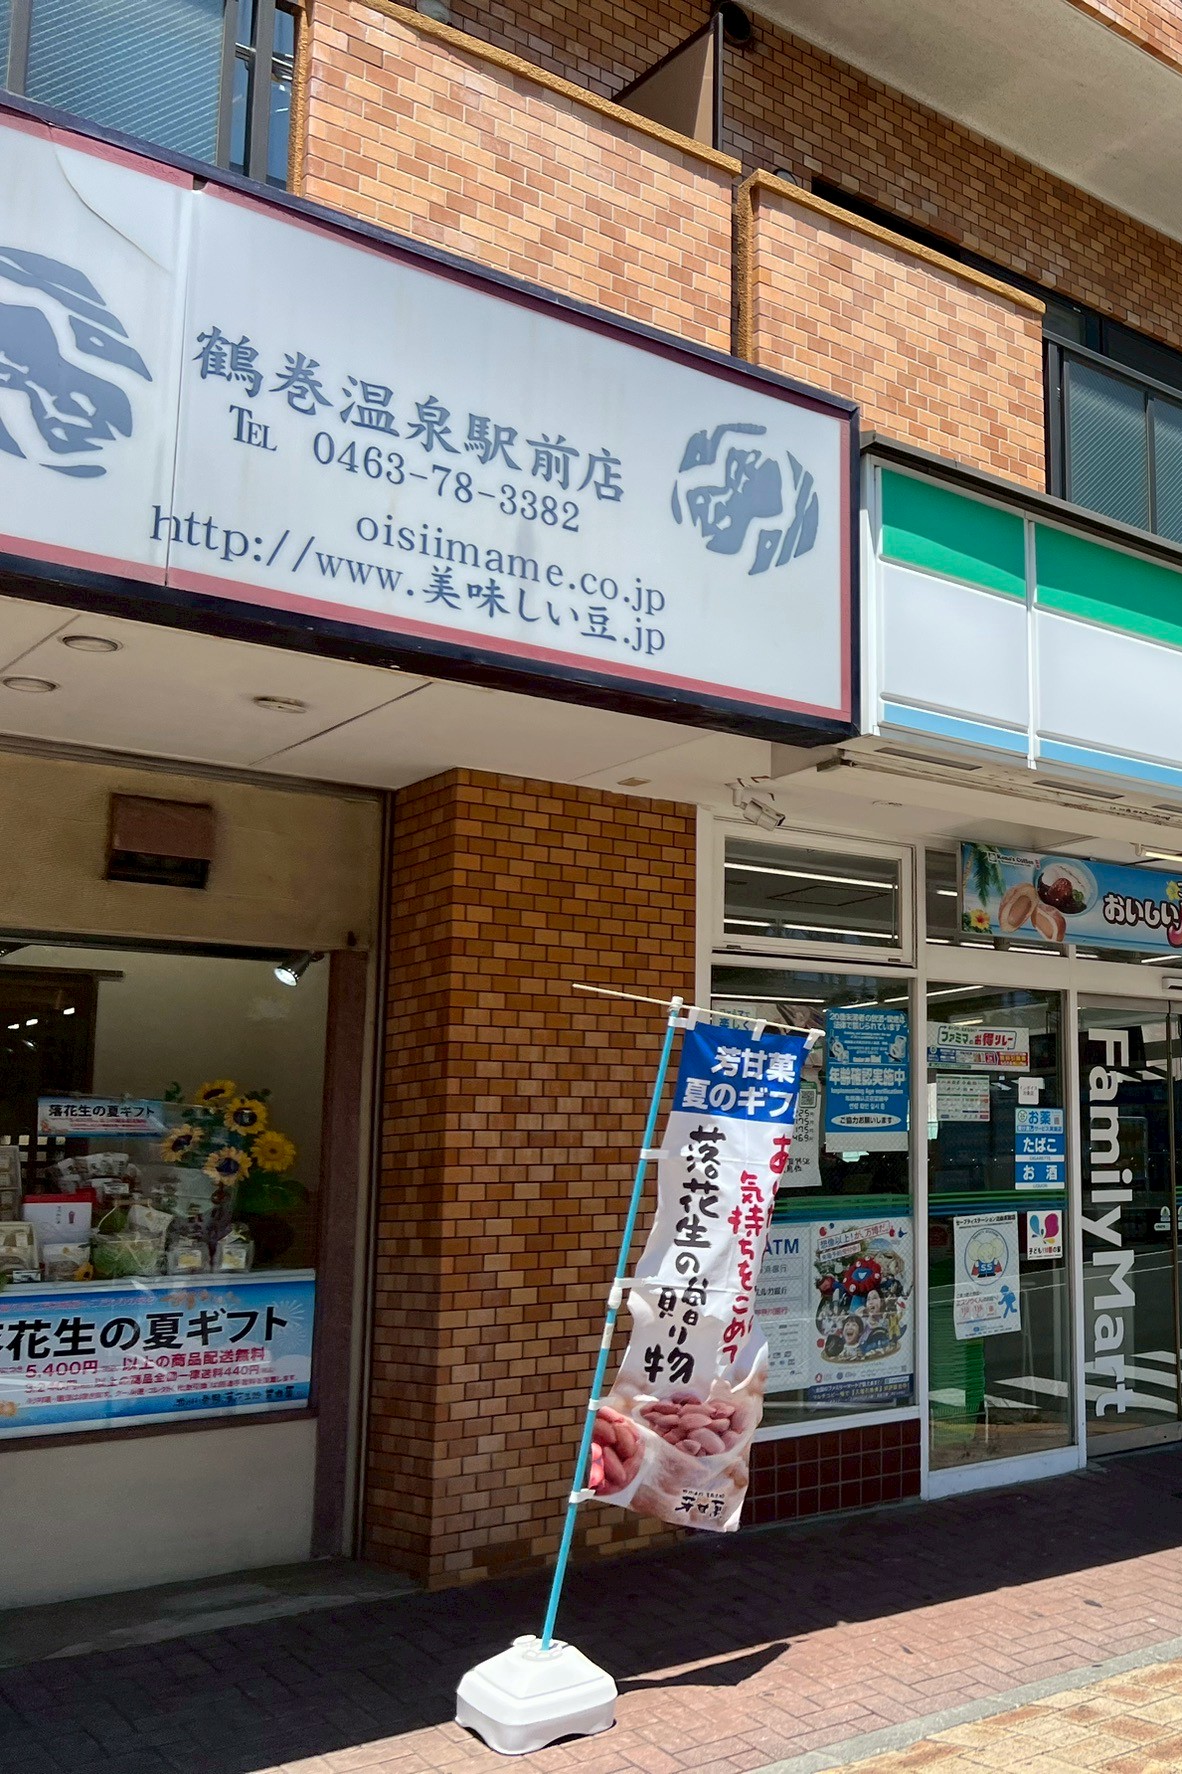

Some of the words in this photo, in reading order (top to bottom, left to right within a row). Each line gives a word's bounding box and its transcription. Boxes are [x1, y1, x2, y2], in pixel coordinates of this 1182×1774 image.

[192, 325, 625, 502] 鶴巻温泉駅前店
[313, 431, 580, 532] 0463-78-3382
[356, 515, 666, 615] oisiimame.co.jp
[711, 1046, 797, 1084] 芳甘菓
[829, 1067, 906, 1086] 年齢確認実施中
[49, 1104, 155, 1118] 落花生の夏ギフト
[682, 1077, 798, 1118] 夏のギフ
[839, 1116, 893, 1124] ご協力お願いします
[1028, 1110, 1051, 1125] お薬
[1023, 1137, 1057, 1153] たばこ
[1081, 1028, 1136, 1417] FamilyMart
[644, 1125, 726, 1384] 落花生の贈り物
[722, 1170, 764, 1364] 気持ちをこめて
[980, 1263, 993, 1271] SS
[0, 1306, 288, 1361] 花生の夏ギフト
[122, 1347, 265, 1371] 以上の商品配送無料
